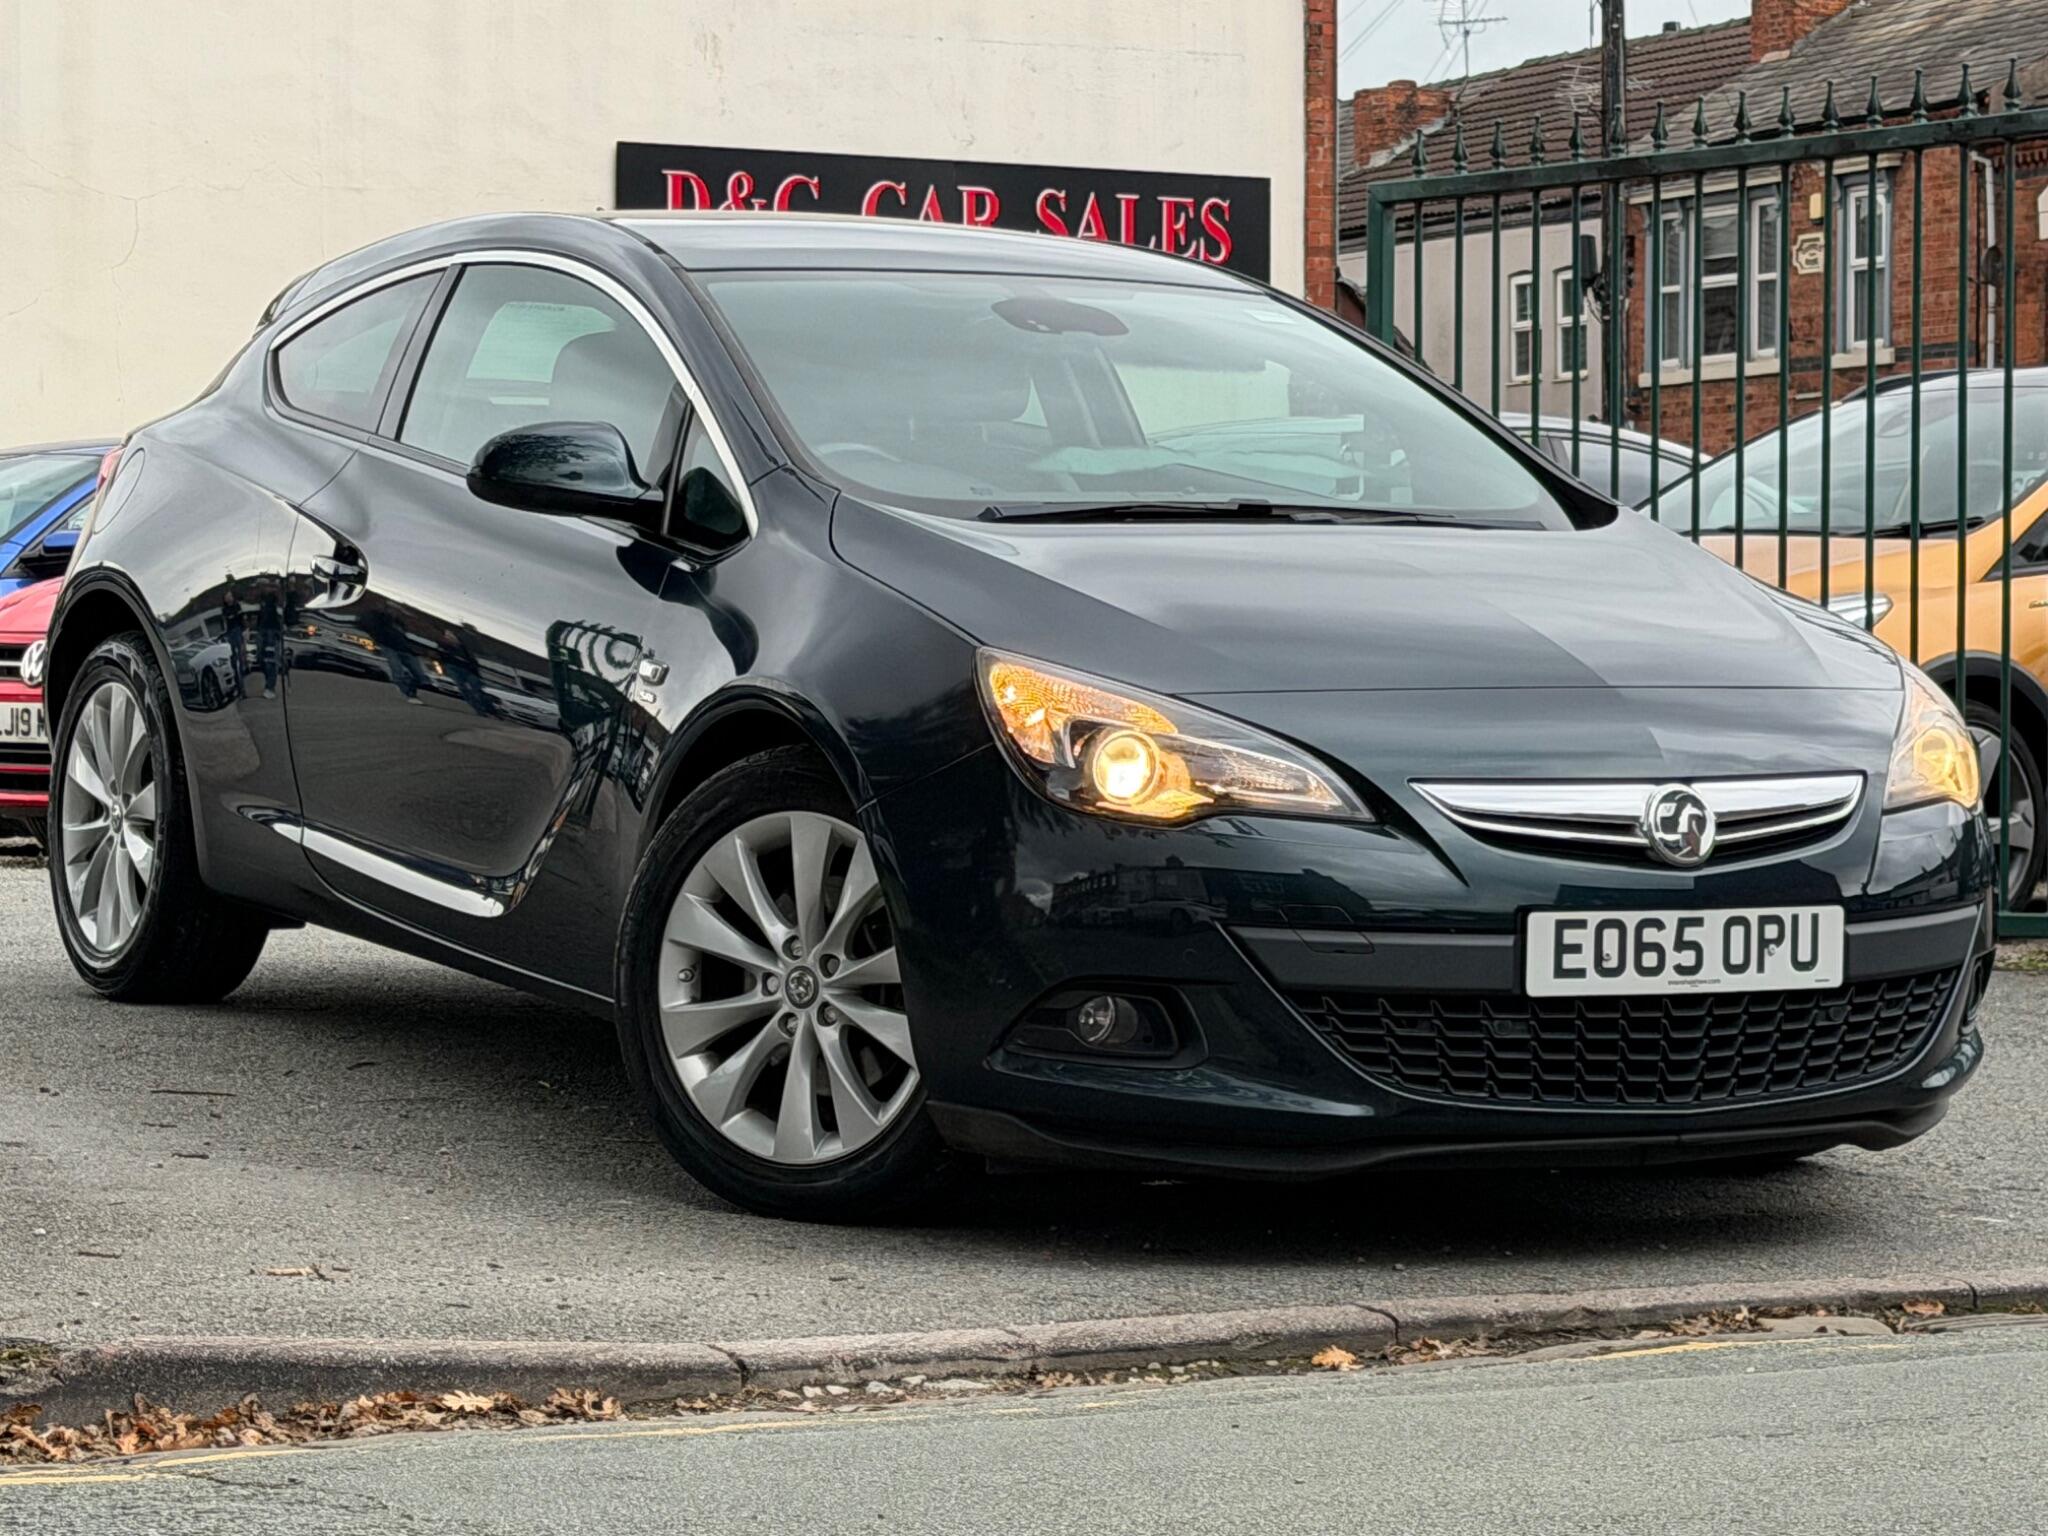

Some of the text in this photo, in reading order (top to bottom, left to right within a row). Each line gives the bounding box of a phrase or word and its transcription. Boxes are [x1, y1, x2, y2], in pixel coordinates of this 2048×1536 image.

[861, 180, 1000, 228] CAR
[1035, 188, 1233, 265] SALES
[0, 707, 31, 737] J19
[1553, 912, 1820, 980] EO65 OPU
